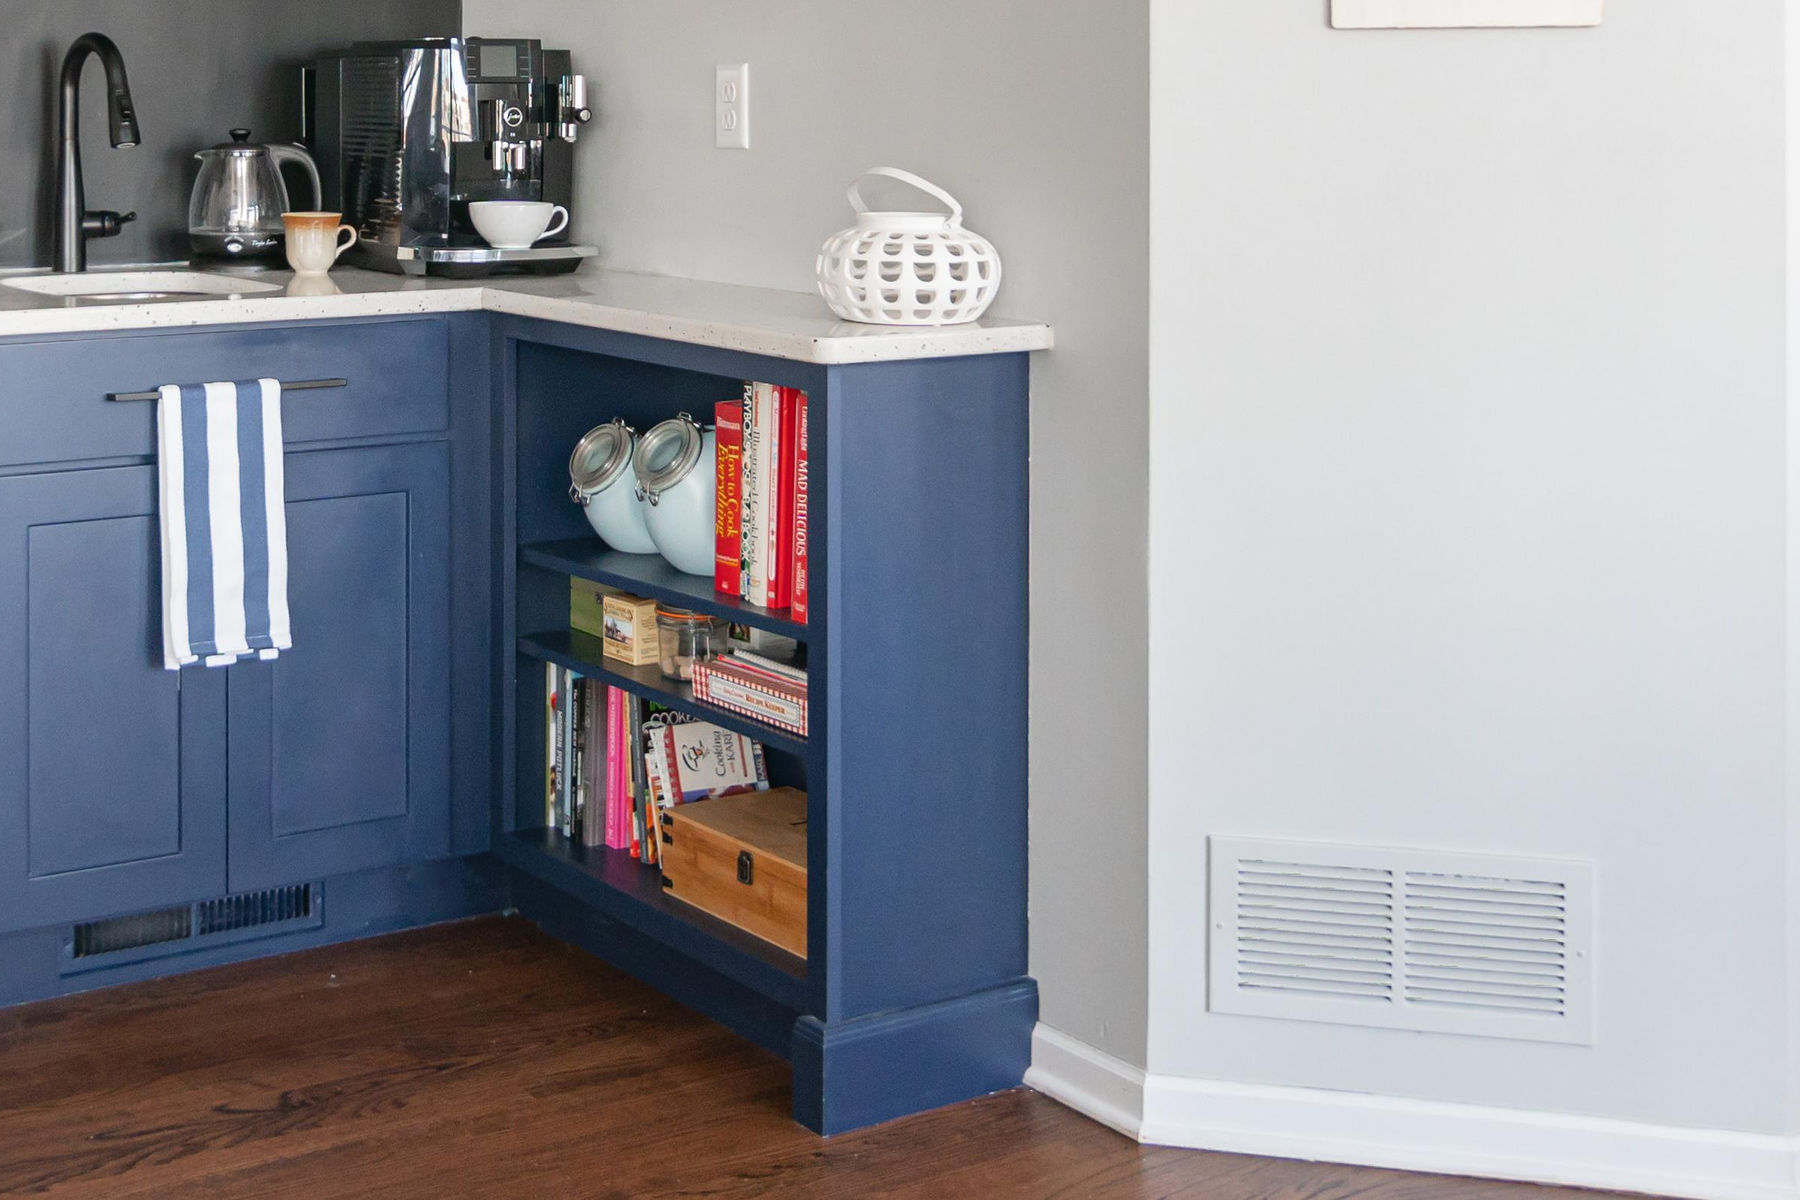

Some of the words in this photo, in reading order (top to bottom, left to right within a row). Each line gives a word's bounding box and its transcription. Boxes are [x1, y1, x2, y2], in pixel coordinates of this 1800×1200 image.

[727, 445, 739, 480] How
[752, 431, 760, 496] Illustrated
[797, 459, 808, 490] MAD
[716, 443, 729, 538] Everything
[727, 481, 736, 495] to
[727, 498, 739, 537] Cook
[751, 500, 759, 566] Cookbook
[796, 493, 808, 556] DELICIOUS
[741, 523, 751, 562] BOOK
[712, 730, 726, 777] Cooking
